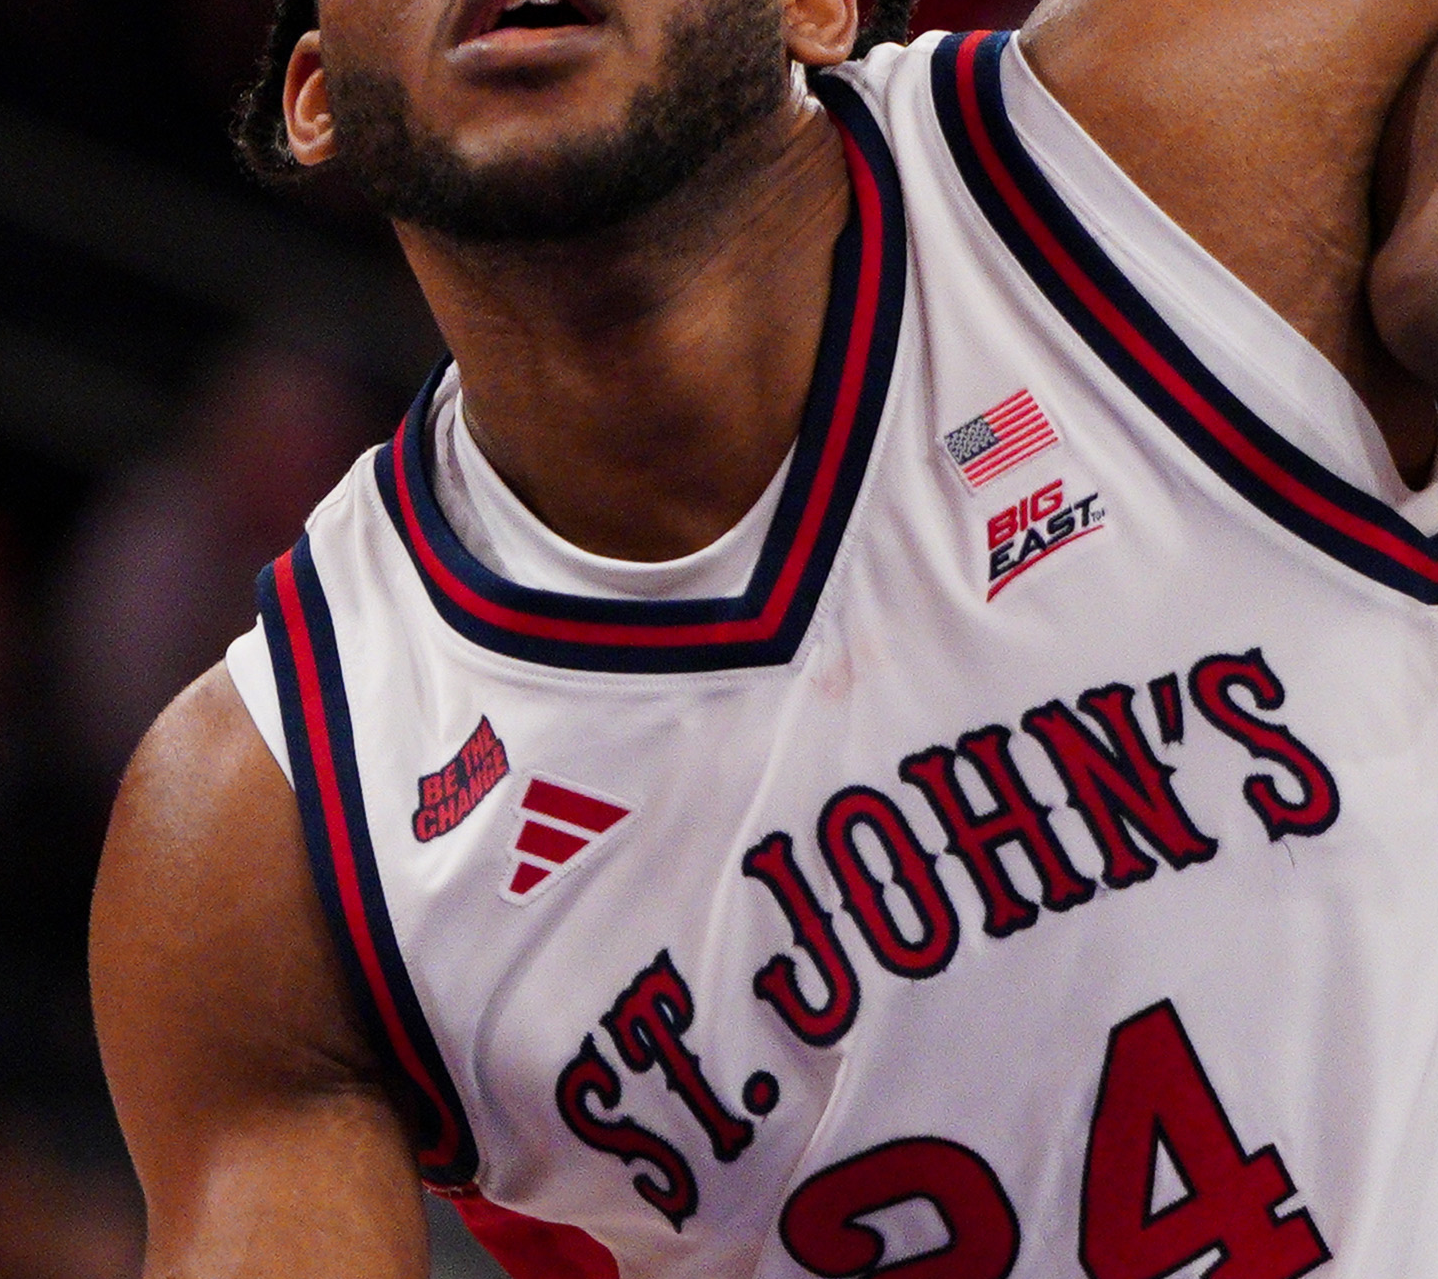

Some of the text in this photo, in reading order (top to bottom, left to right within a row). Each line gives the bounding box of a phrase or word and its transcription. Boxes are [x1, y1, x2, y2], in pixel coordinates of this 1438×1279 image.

[987, 479, 1063, 551] BIG
[989, 492, 1099, 582] EAST
[415, 742, 508, 840] CHANGE
[422, 761, 459, 807] BE
[554, 647, 1342, 1232] ST. JOHN'S
